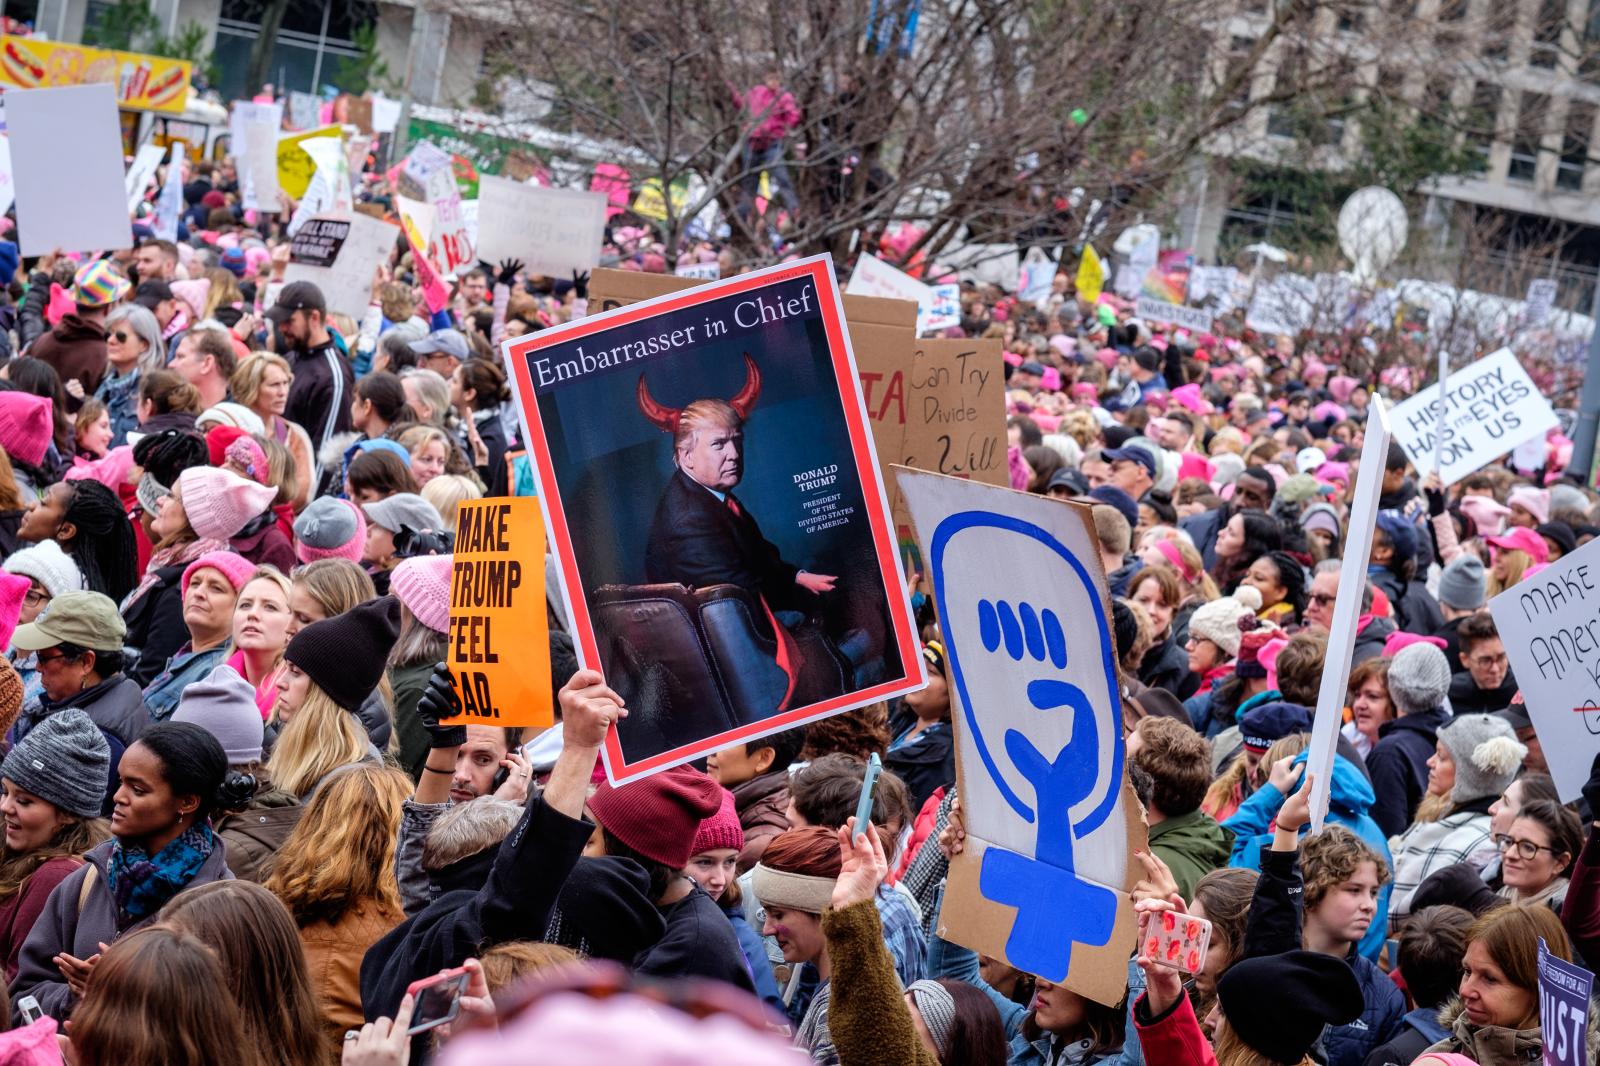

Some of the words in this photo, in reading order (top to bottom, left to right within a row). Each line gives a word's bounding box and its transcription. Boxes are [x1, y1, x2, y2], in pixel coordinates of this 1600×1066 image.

[533, 326, 696, 387] Embarrasser
[705, 317, 728, 339] in
[734, 285, 811, 328] Chief
[912, 350, 950, 389] Can
[956, 352, 989, 397] Try
[924, 396, 978, 424] Divide
[1407, 367, 1505, 431] HISTORY
[1469, 380, 1530, 422] EYES
[937, 432, 1000, 475] Will
[1440, 437, 1475, 466] ON
[1484, 411, 1521, 439] US
[793, 464, 838, 483] DONALD
[799, 475, 837, 492] TRUMP
[798, 515, 827, 528] DIVIDED
[828, 507, 854, 519] STATES
[802, 493, 841, 509] PRESIDENT
[811, 507, 821, 515] OF
[821, 503, 837, 513] THE
[456, 505, 511, 553] MAKE
[806, 526, 816, 534] OF
[817, 517, 850, 531] AMERICA
[452, 561, 521, 608] TRUMP
[1520, 565, 1595, 623] MAKE
